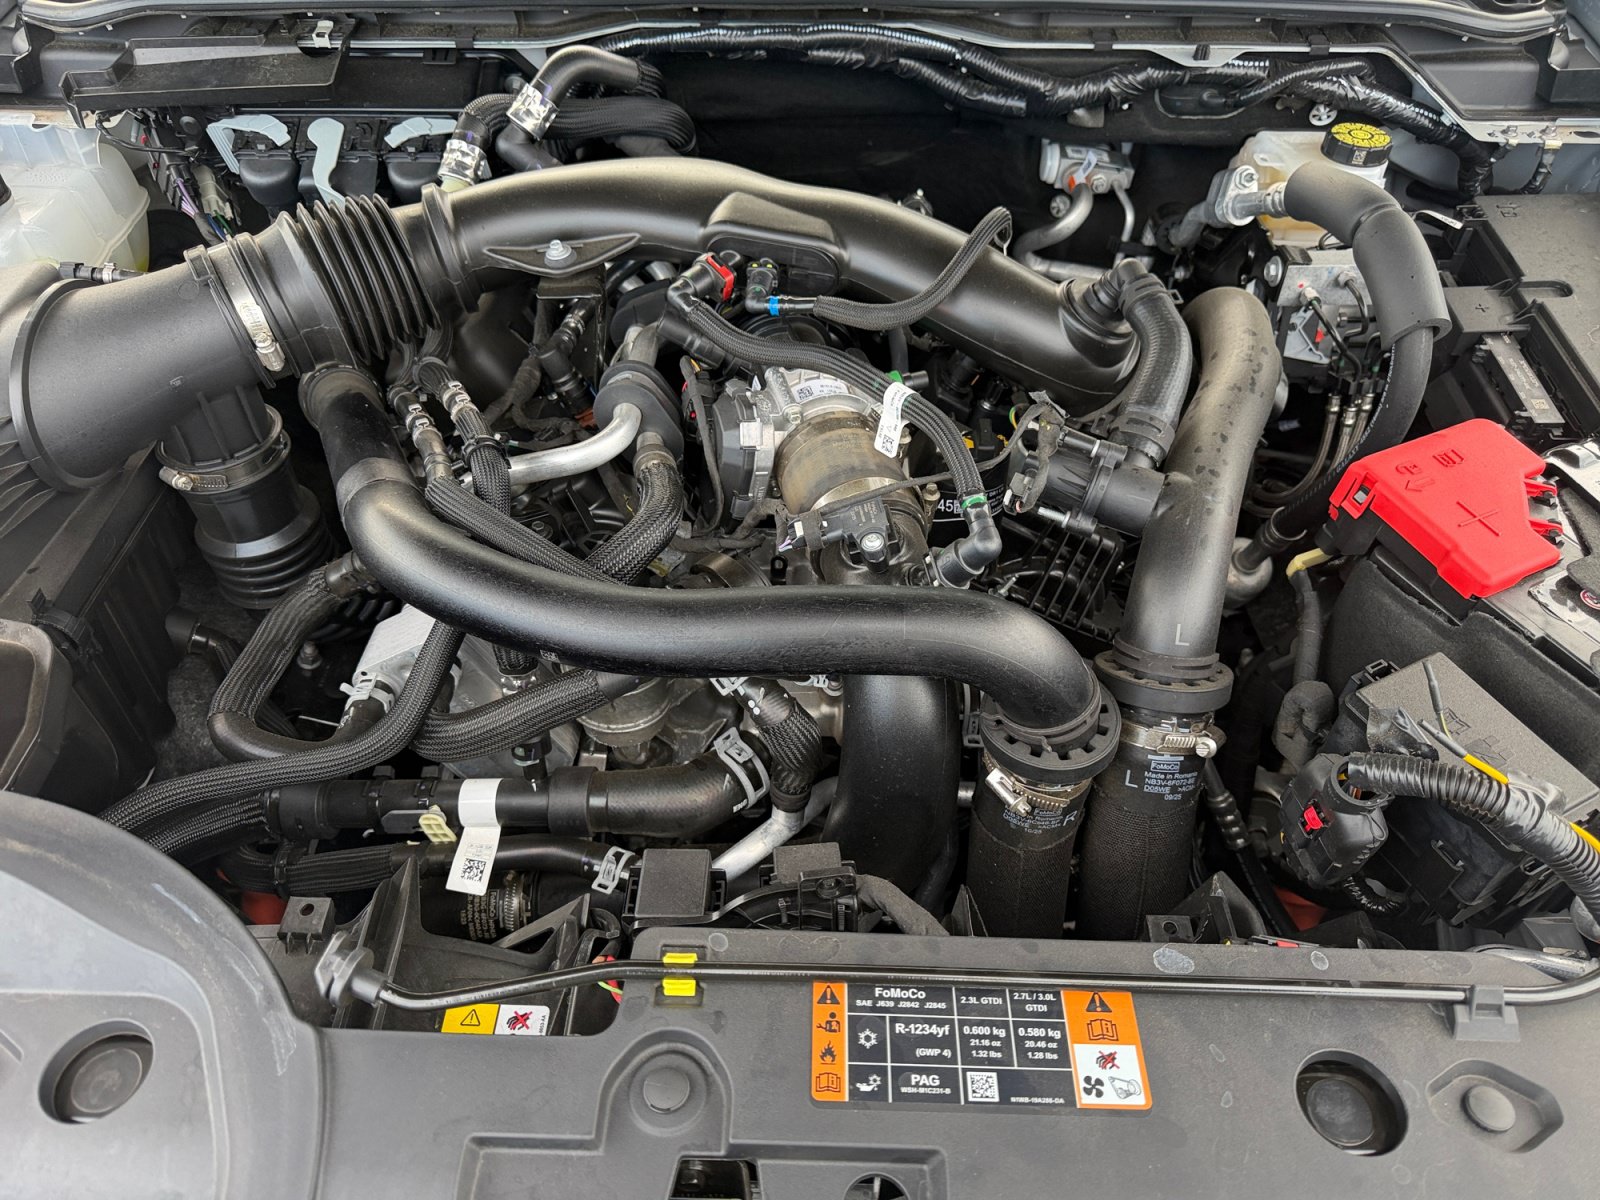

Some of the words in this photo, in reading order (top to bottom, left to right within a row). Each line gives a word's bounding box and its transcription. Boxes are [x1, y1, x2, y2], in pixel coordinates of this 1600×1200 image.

[1175, 623, 1190, 646] L
[1152, 763, 1179, 771] FoMoCo
[1125, 769, 1139, 788] L
[1144, 771, 1165, 779] Made
[1164, 793, 1183, 801] 09/25
[1063, 810, 1078, 827] R
[489, 891, 497, 918] FoMoCo
[875, 987, 926, 999] FoMoCo
[1013, 992, 1032, 1000] 2.7L
[1038, 993, 1056, 1001] 3.0L
[856, 999, 873, 1007] SAE
[960, 996, 979, 1004] 2.3L
[981, 997, 1003, 1005] GTDI
[1025, 1004, 1048, 1012] GTDI
[895, 1023, 951, 1037] R-1234yf
[963, 1026, 991, 1035] 0.600
[992, 1027, 1006, 1038] kg
[1018, 1027, 1046, 1037] 0.580
[1048, 1028, 1062, 1039] kg
[970, 1038, 990, 1046] 21.16
[1024, 1040, 1046, 1048] 20.46
[915, 1047, 940, 1058] (GWP
[942, 1048, 952, 1059] 4)
[971, 1050, 988, 1058] 1.32
[989, 1050, 1003, 1058] lbs
[1027, 1051, 1044, 1059] 1.28
[1045, 1052, 1059, 1060] lbs
[911, 1074, 940, 1086] PAG
